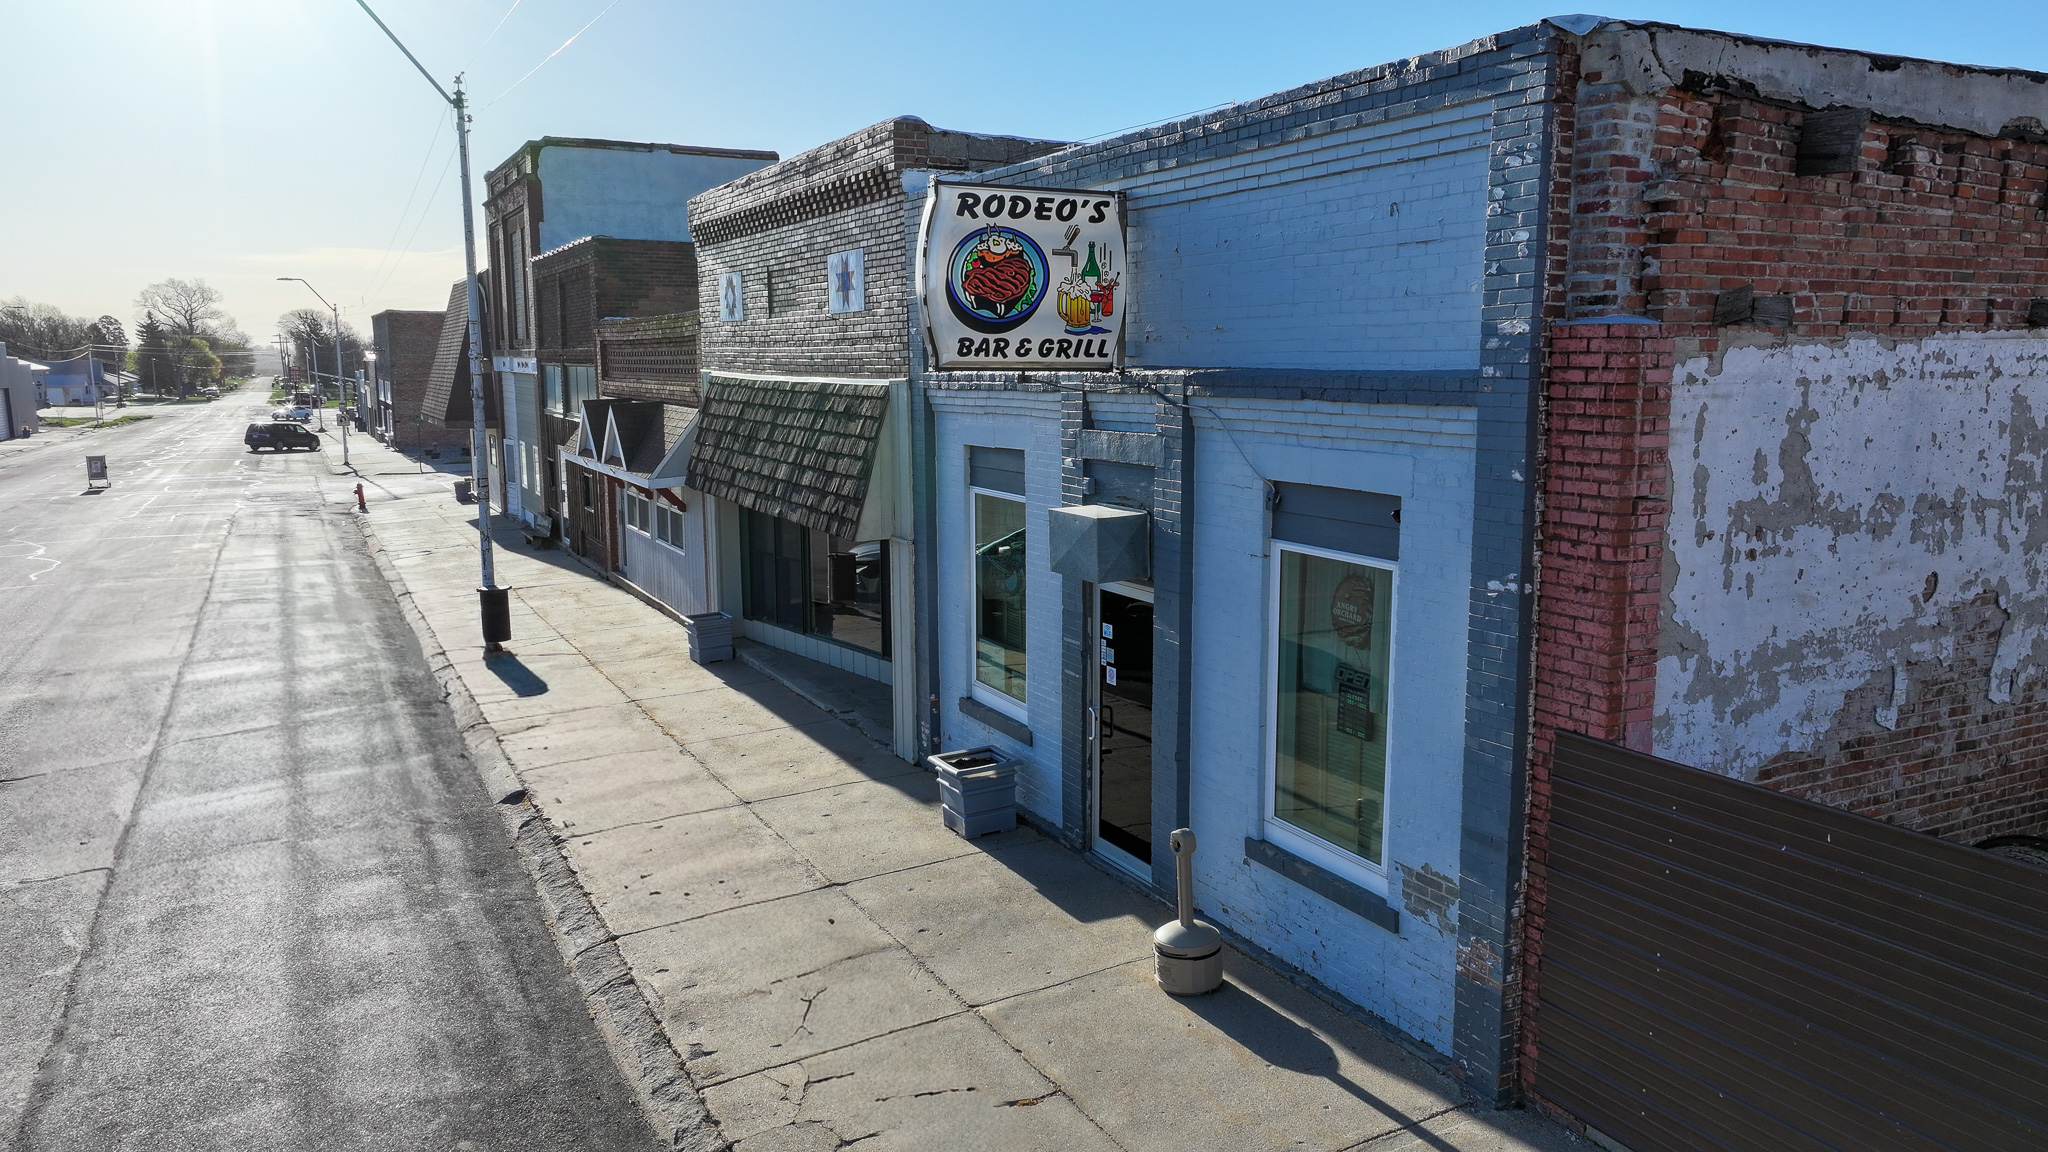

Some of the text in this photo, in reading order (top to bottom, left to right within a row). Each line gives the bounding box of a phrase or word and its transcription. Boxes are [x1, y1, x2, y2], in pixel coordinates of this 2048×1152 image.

[955, 192, 1110, 224] RODEO'S
[957, 337, 1110, 360] BAR & GRILL
[1332, 608, 1362, 623] ORCHARD
[1336, 601, 1358, 614] ANGRY
[1336, 667, 1371, 689] OPEN
